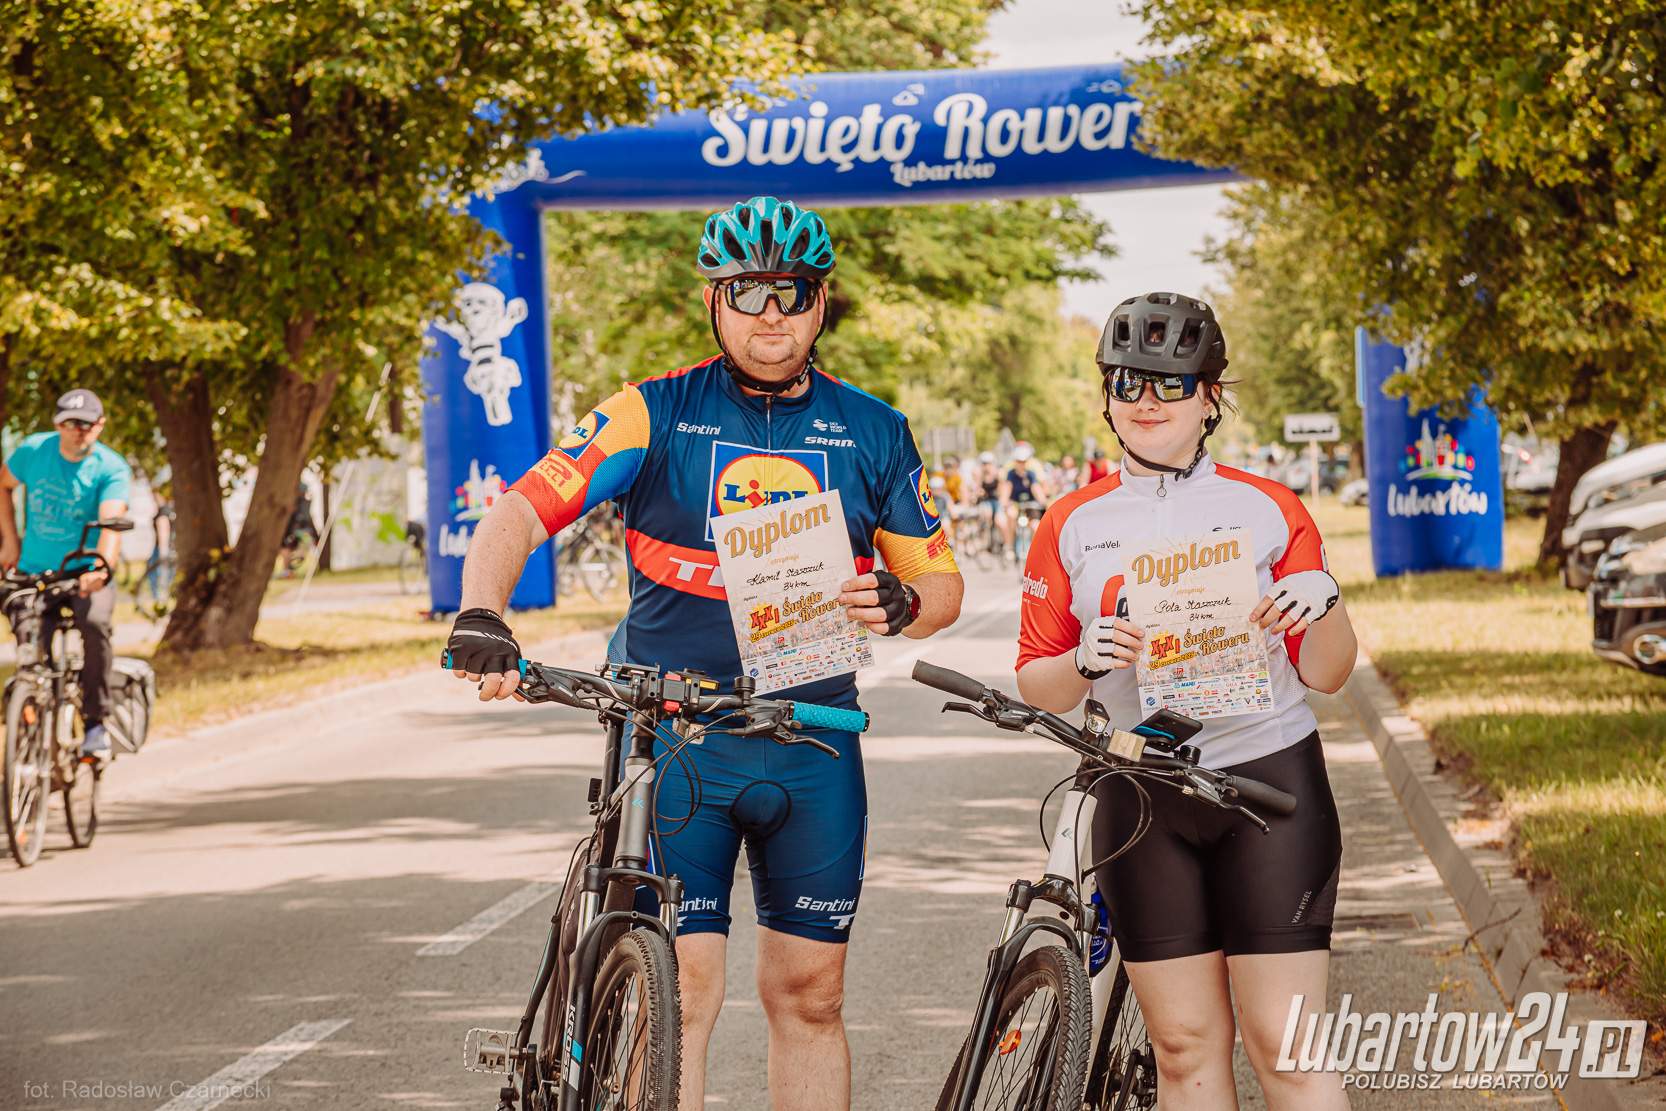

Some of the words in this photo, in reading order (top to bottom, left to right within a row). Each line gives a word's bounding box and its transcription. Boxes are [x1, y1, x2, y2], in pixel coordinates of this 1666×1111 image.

[933, 92, 1143, 160] Rower
[676, 422, 722, 436] Santini
[723, 503, 831, 559] Dyplom
[1131, 540, 1241, 587] Dyplom
[783, 591, 824, 617] Święto
[1183, 625, 1226, 648] Święto
[1200, 631, 1250, 657] Roweru
[677, 897, 718, 912] antini
[795, 896, 856, 912] Santini
[562, 1003, 576, 1083] KROSS
